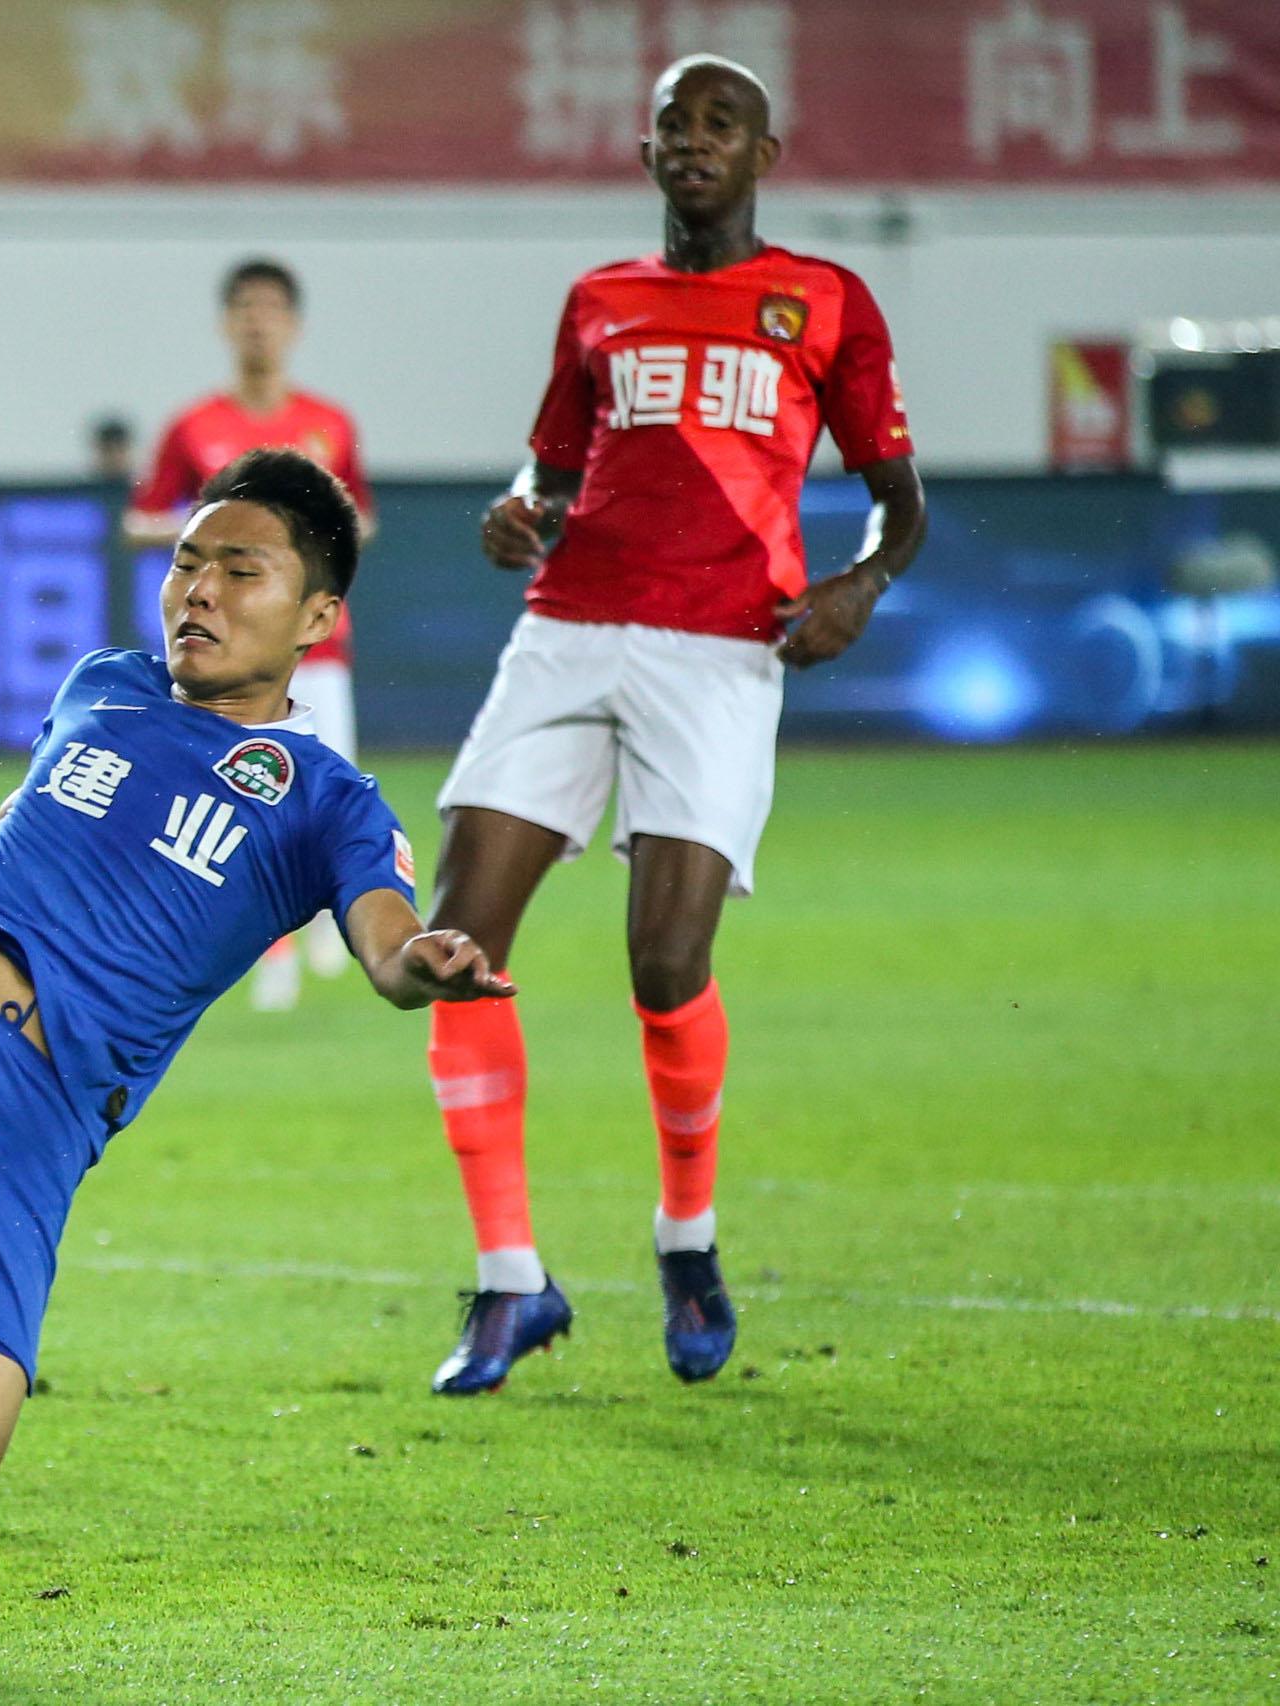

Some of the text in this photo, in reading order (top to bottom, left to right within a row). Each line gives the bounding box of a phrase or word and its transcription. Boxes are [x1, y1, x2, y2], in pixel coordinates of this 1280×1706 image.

[967, 0, 1242, 162] 向上
[609, 345, 783, 436] 恒驰
[35, 741, 249, 888] 建业
